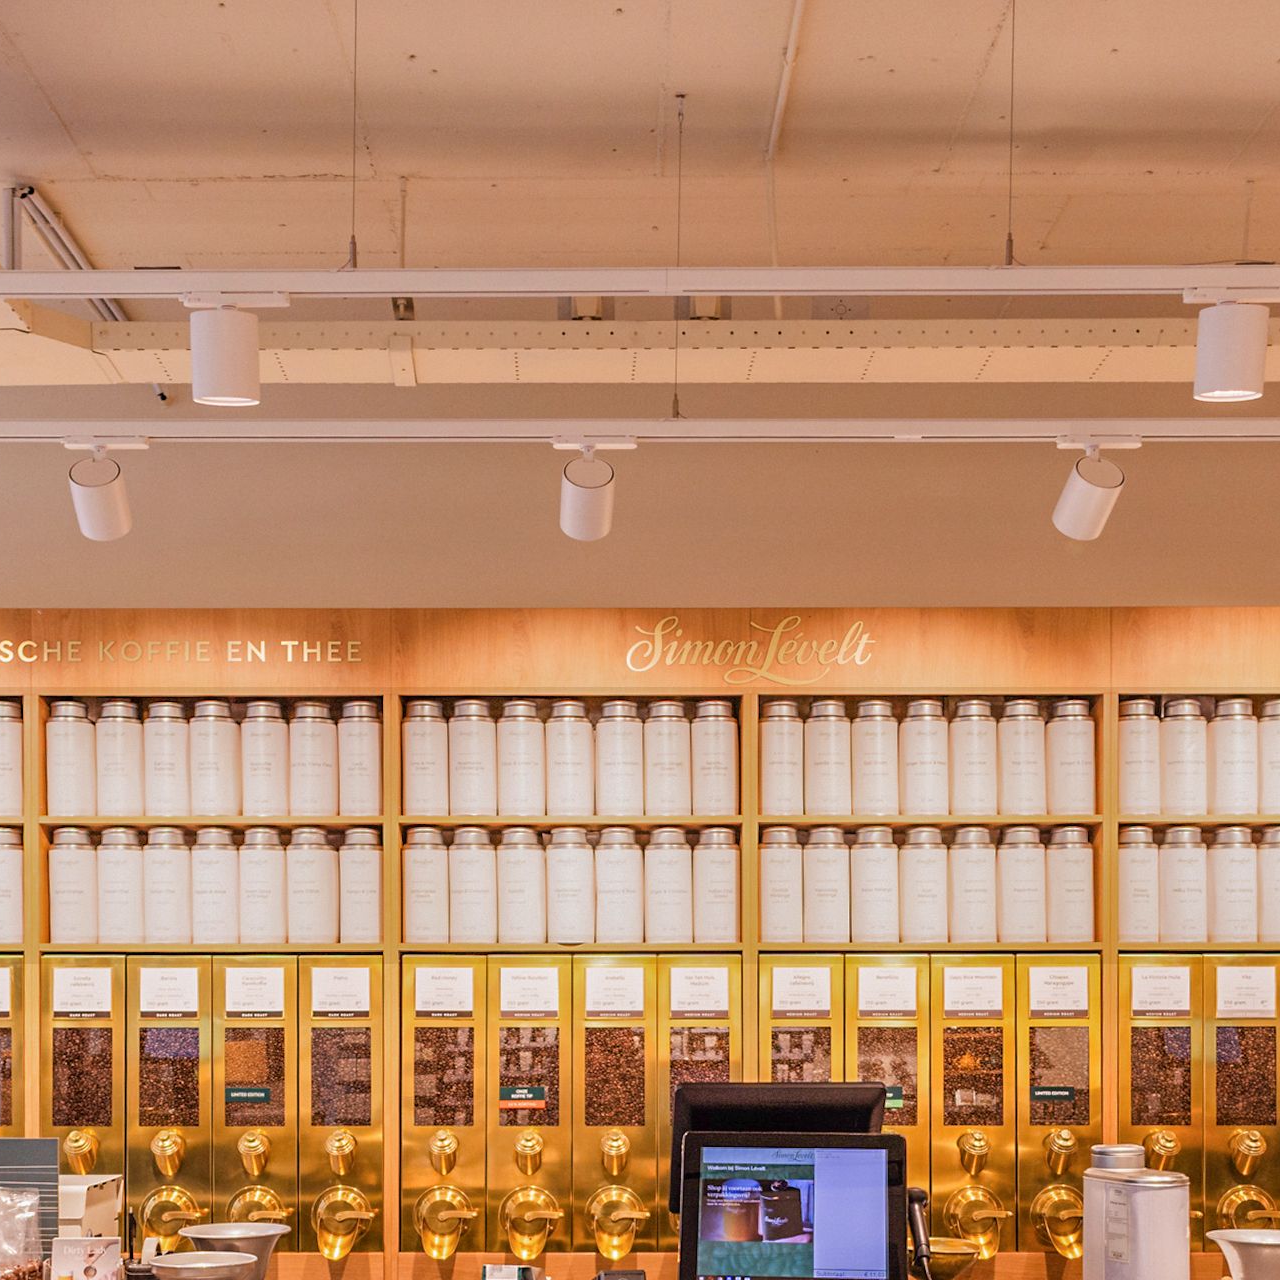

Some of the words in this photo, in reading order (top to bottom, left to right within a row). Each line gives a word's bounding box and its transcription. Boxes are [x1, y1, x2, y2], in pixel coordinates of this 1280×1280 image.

[98, 640, 211, 662] KOFFIE
[227, 640, 266, 662] EN
[281, 640, 362, 662] THEE
[626, 616, 762, 672] Simon
[724, 616, 876, 685] Lévelt
